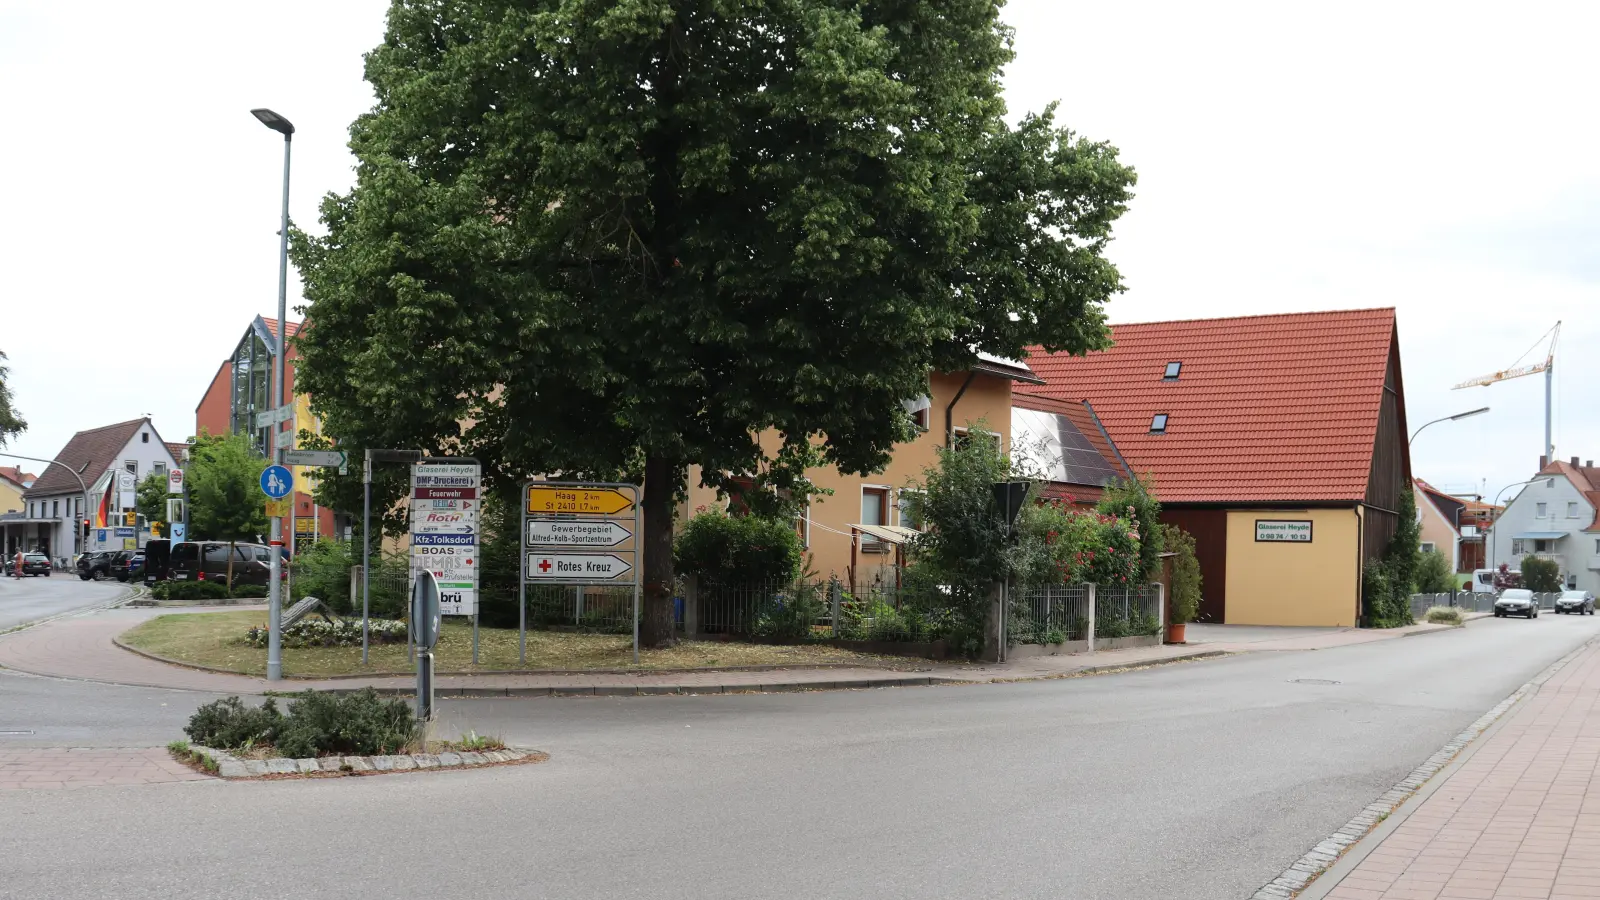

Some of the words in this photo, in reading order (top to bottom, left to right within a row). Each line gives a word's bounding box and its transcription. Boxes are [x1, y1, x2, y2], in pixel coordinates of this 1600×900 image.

[450, 466, 474, 474] Heyde
[416, 476, 469, 485] DMP-Druckerei
[555, 492, 576, 501] Haag
[551, 525, 612, 534] Gewerbegebiet
[415, 535, 473, 544] Kfz-Tolksdorf
[532, 534, 612, 543] Alfred-Kolb-Sportzentrum
[421, 547, 455, 555] BOAS
[557, 561, 582, 572] Rotes
[586, 562, 611, 572] Kreuz
[440, 591, 462, 603] brü
